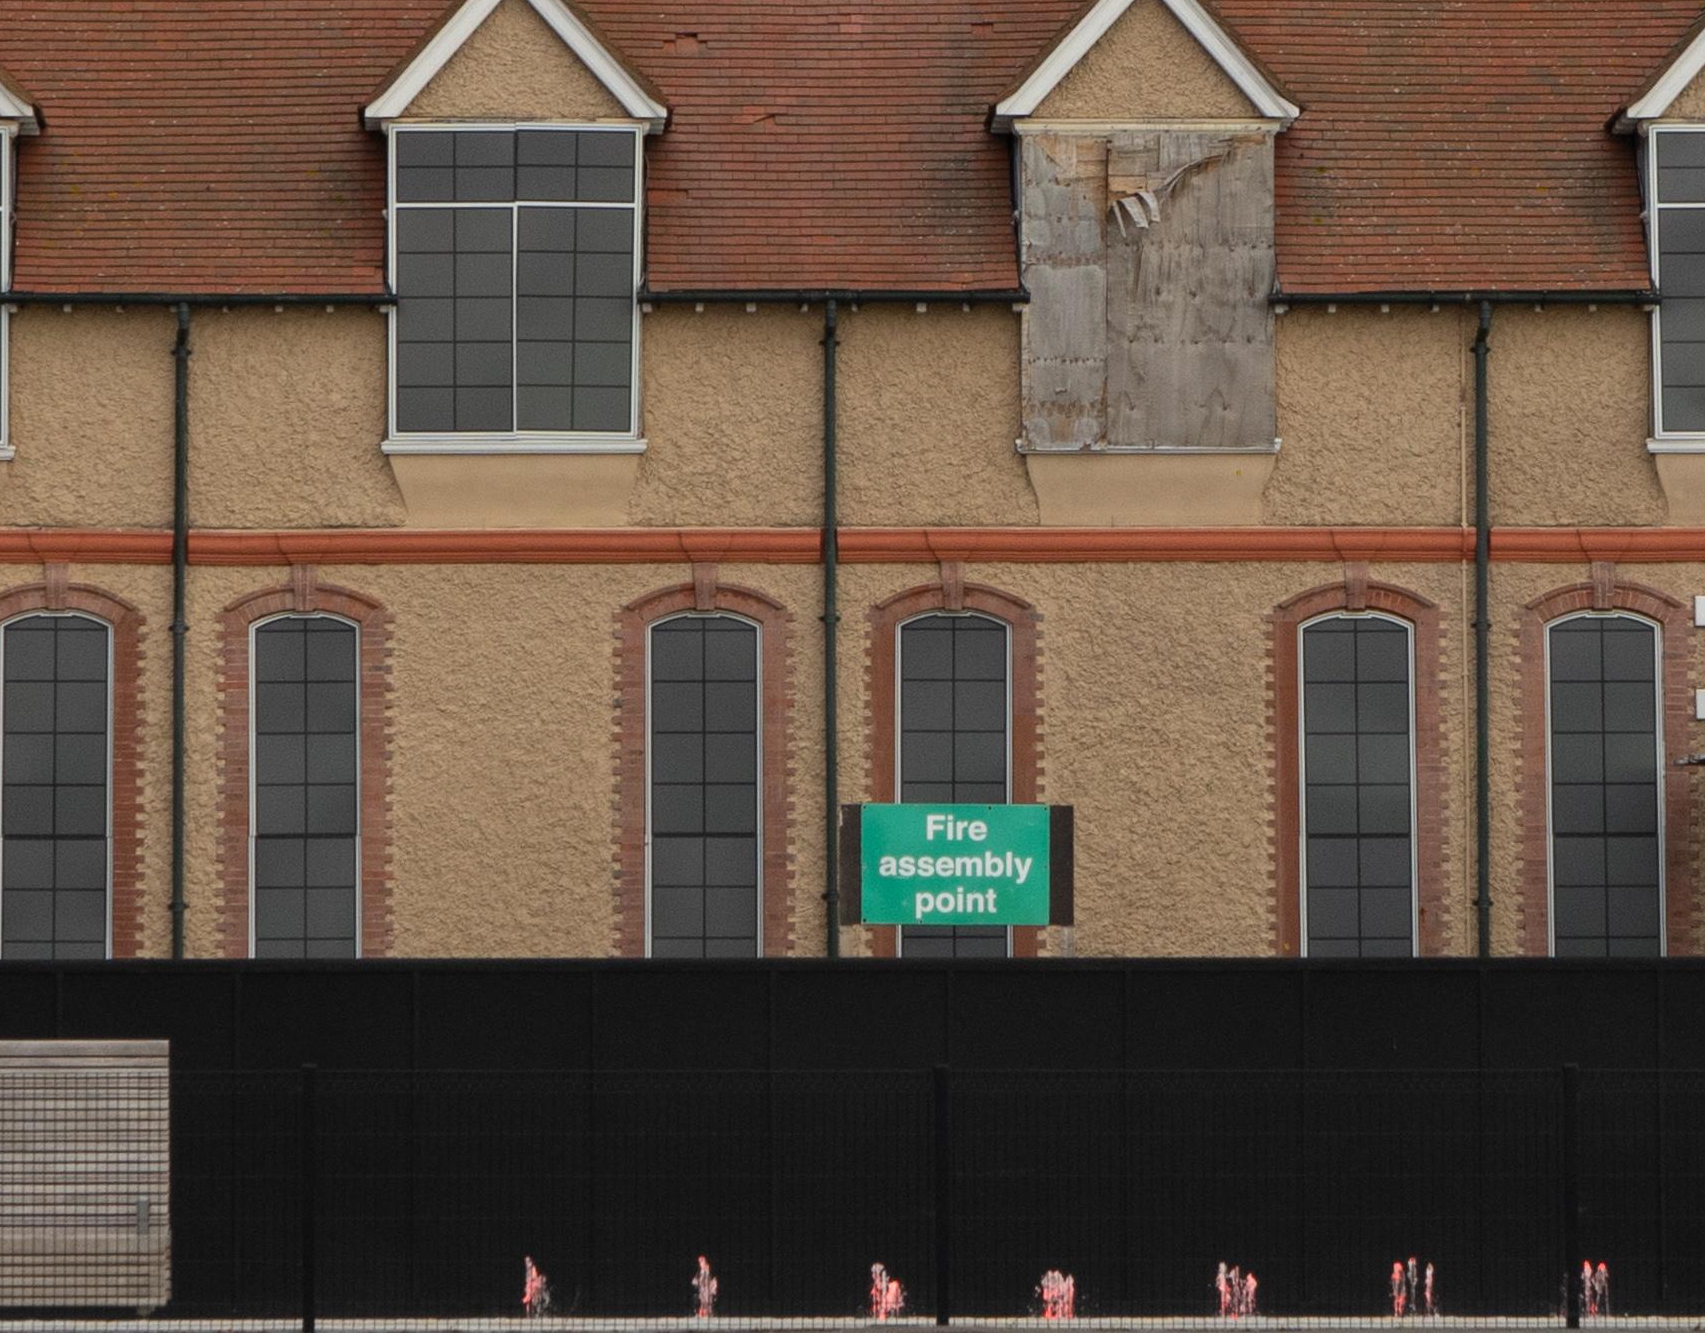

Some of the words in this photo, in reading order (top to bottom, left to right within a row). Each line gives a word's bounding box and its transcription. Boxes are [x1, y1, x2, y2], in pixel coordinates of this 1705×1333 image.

[926, 814, 988, 841] Fire
[879, 851, 1032, 884] assembly
[915, 887, 997, 918] point
